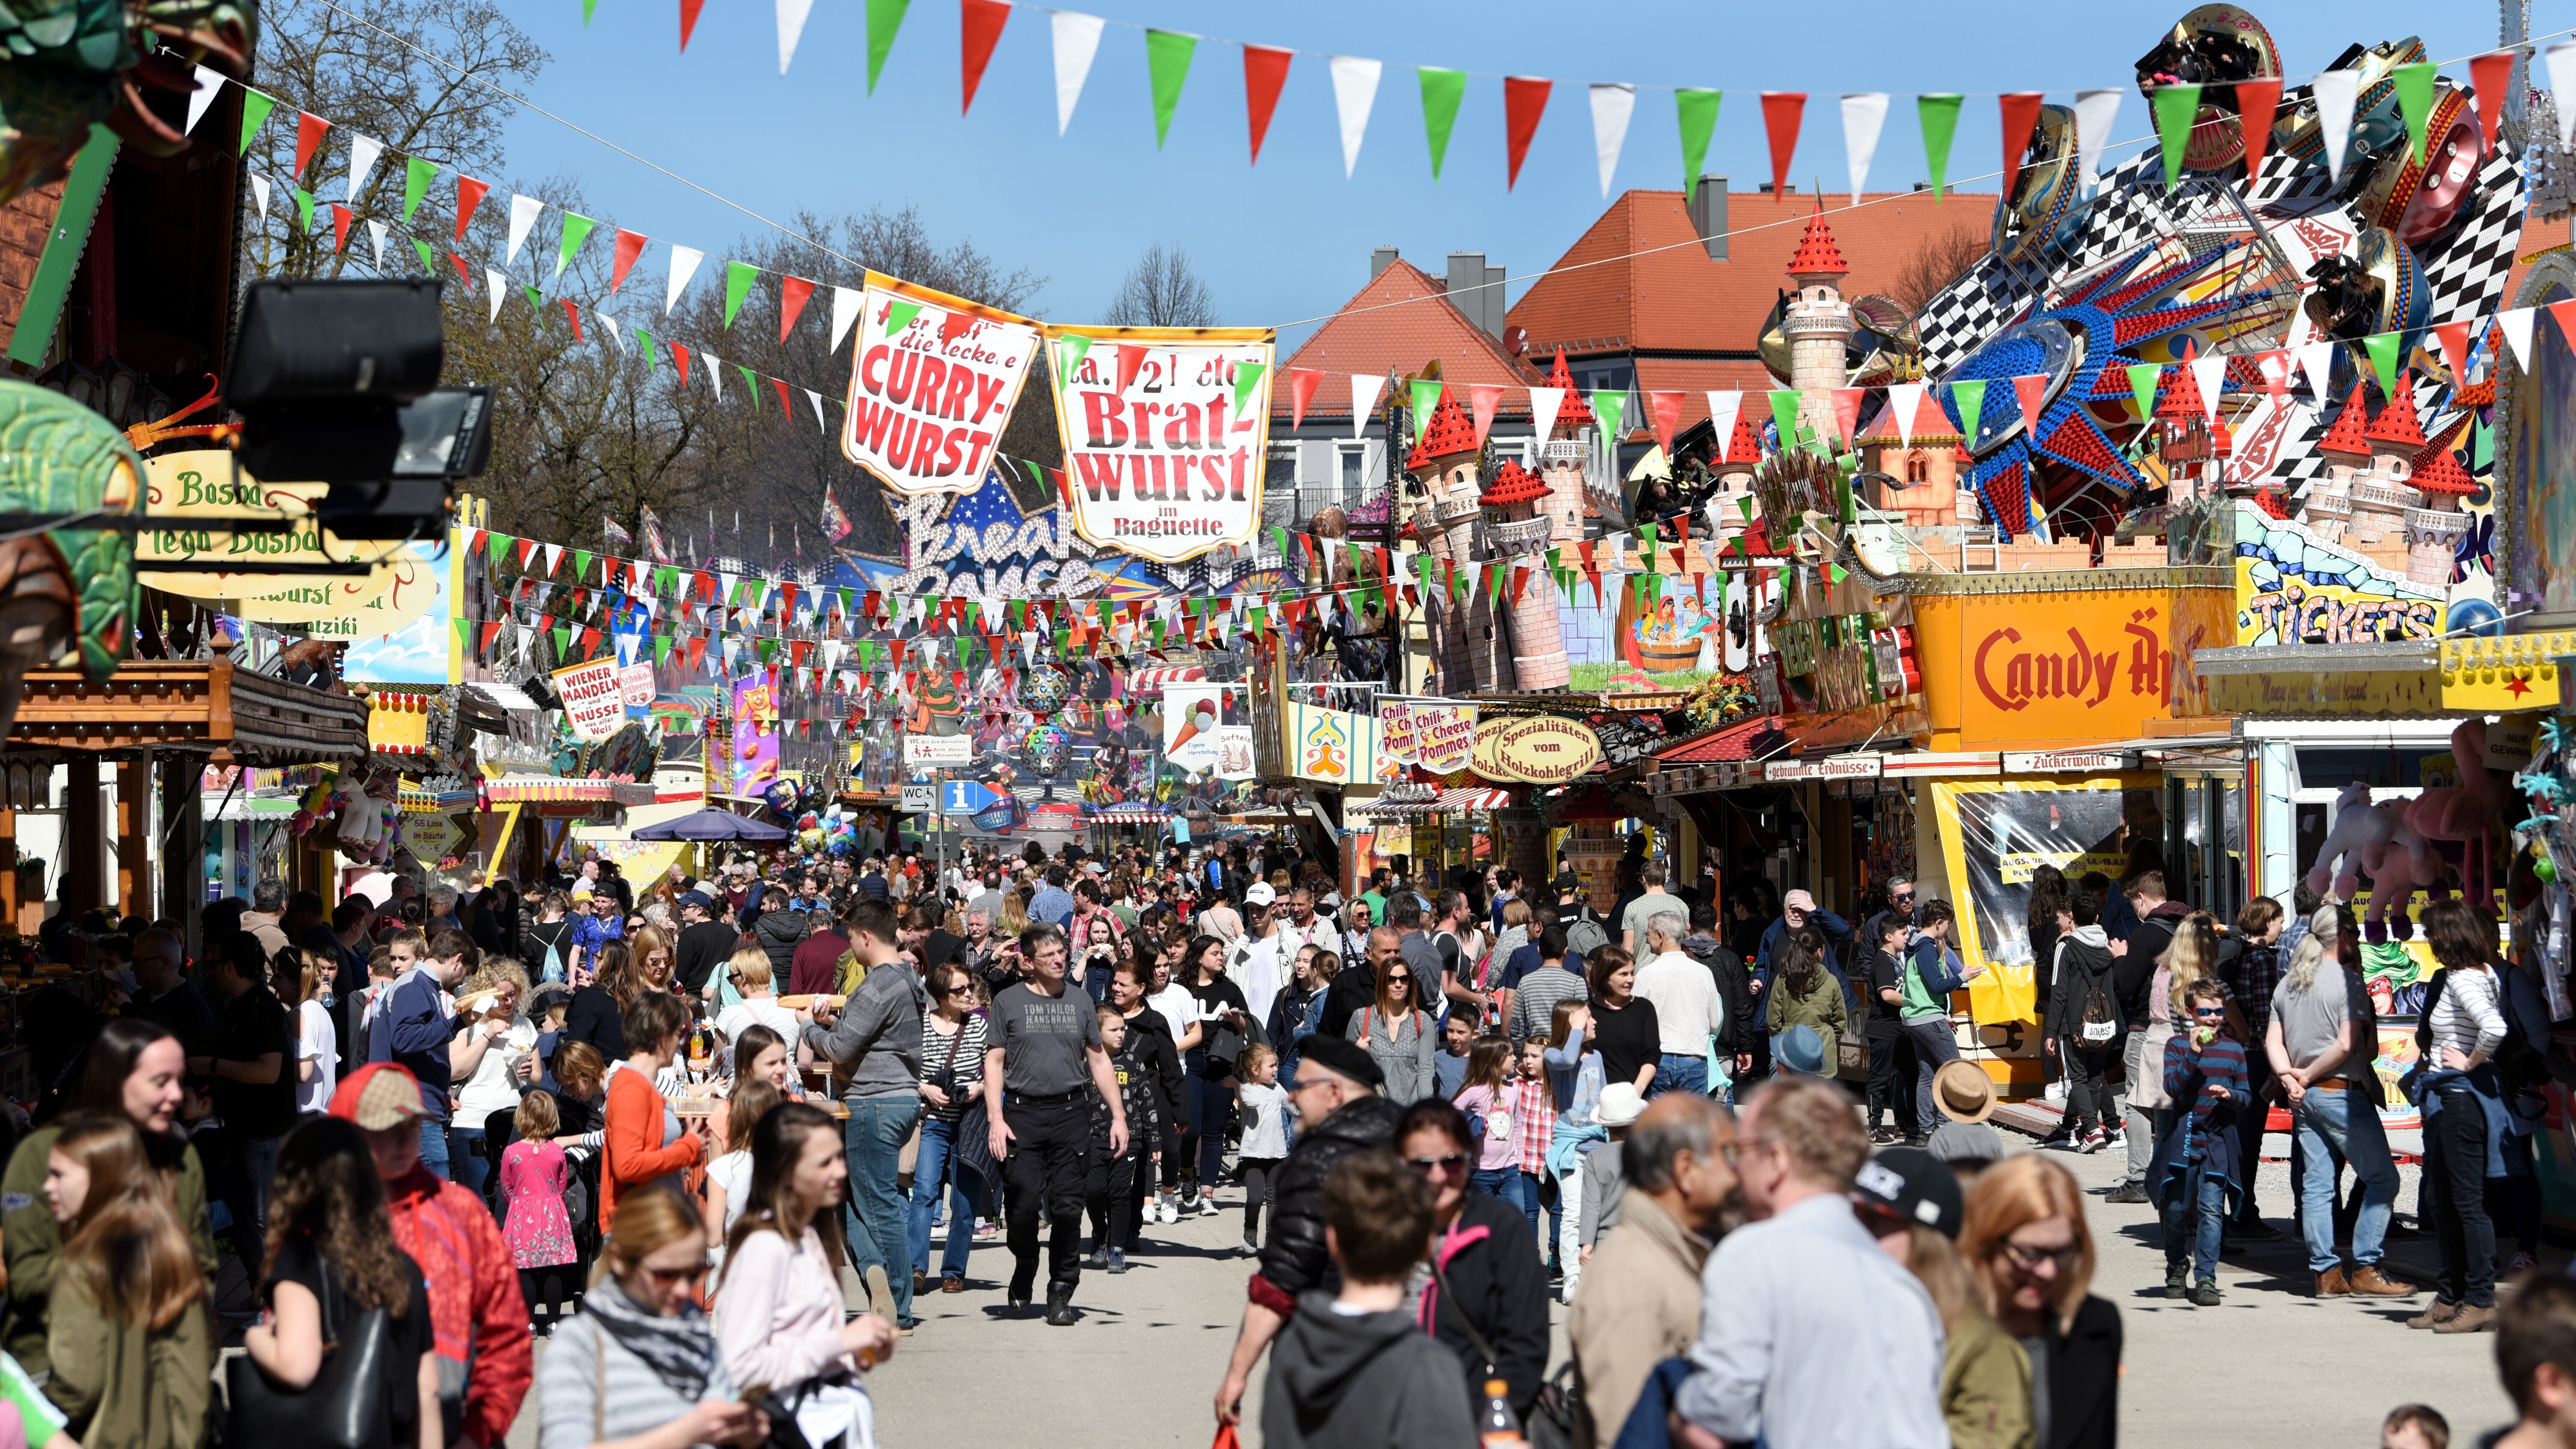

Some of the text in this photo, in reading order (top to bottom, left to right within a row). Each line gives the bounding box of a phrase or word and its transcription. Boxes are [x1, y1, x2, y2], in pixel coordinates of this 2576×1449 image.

[900, 331, 1016, 368] die leckee
[862, 344, 1006, 425] CURRY-
[1080, 392, 1254, 450] Brat-
[855, 397, 993, 478] WURST
[1073, 445, 1249, 501] wurst
[1158, 505, 1177, 516] im
[897, 486, 1097, 569] Break
[1113, 518, 1223, 538] Baguette
[246, 581, 333, 605] wurst
[564, 667, 612, 688] WIENER
[1974, 627, 2119, 712] Candy
[563, 677, 621, 702] MANDELN
[574, 704, 619, 723] NÜSSE
[1382, 703, 1410, 720] Chili-
[1416, 710, 1446, 729] Chili-
[591, 725, 612, 735] Welt
[1221, 734, 1251, 743] Softeis
[1432, 720, 1471, 739] Cheese
[1503, 720, 1590, 748] Spezialitäten
[1419, 736, 1469, 762] Pommes
[1533, 744, 1561, 752] vom
[1500, 745, 1594, 779] Holzkohlegrill
[1772, 761, 1868, 779] gebrannte Erdnüsse
[2033, 755, 2107, 769] Zuckerwatte
[904, 788, 922, 798] WC
[1023, 1003, 1075, 1015] TOM TAILOR
[1026, 1015, 1076, 1024] JEANS BRAND
